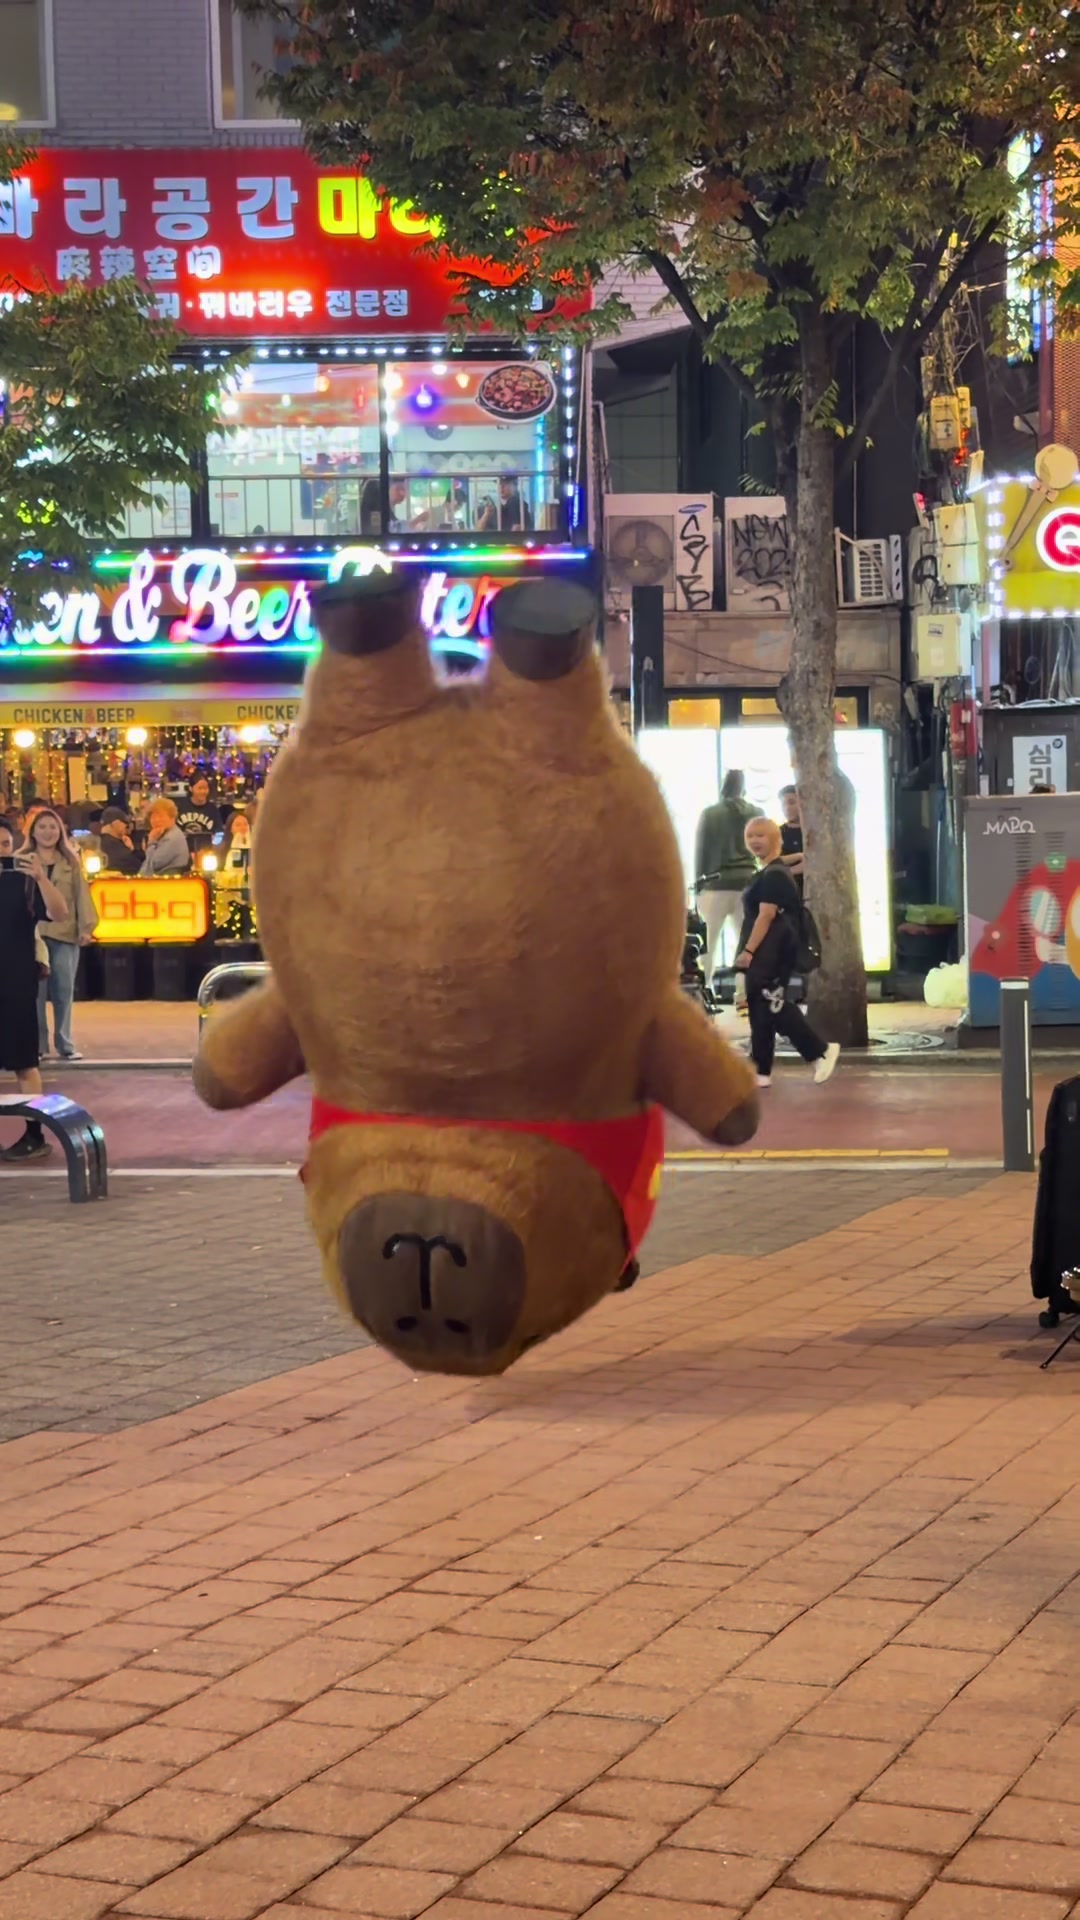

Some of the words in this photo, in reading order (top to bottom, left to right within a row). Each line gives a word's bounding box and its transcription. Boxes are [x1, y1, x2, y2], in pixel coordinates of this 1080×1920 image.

[325, 289, 408, 318] 전문점
[111, 552, 162, 642] &
[168, 549, 316, 643] Beer
